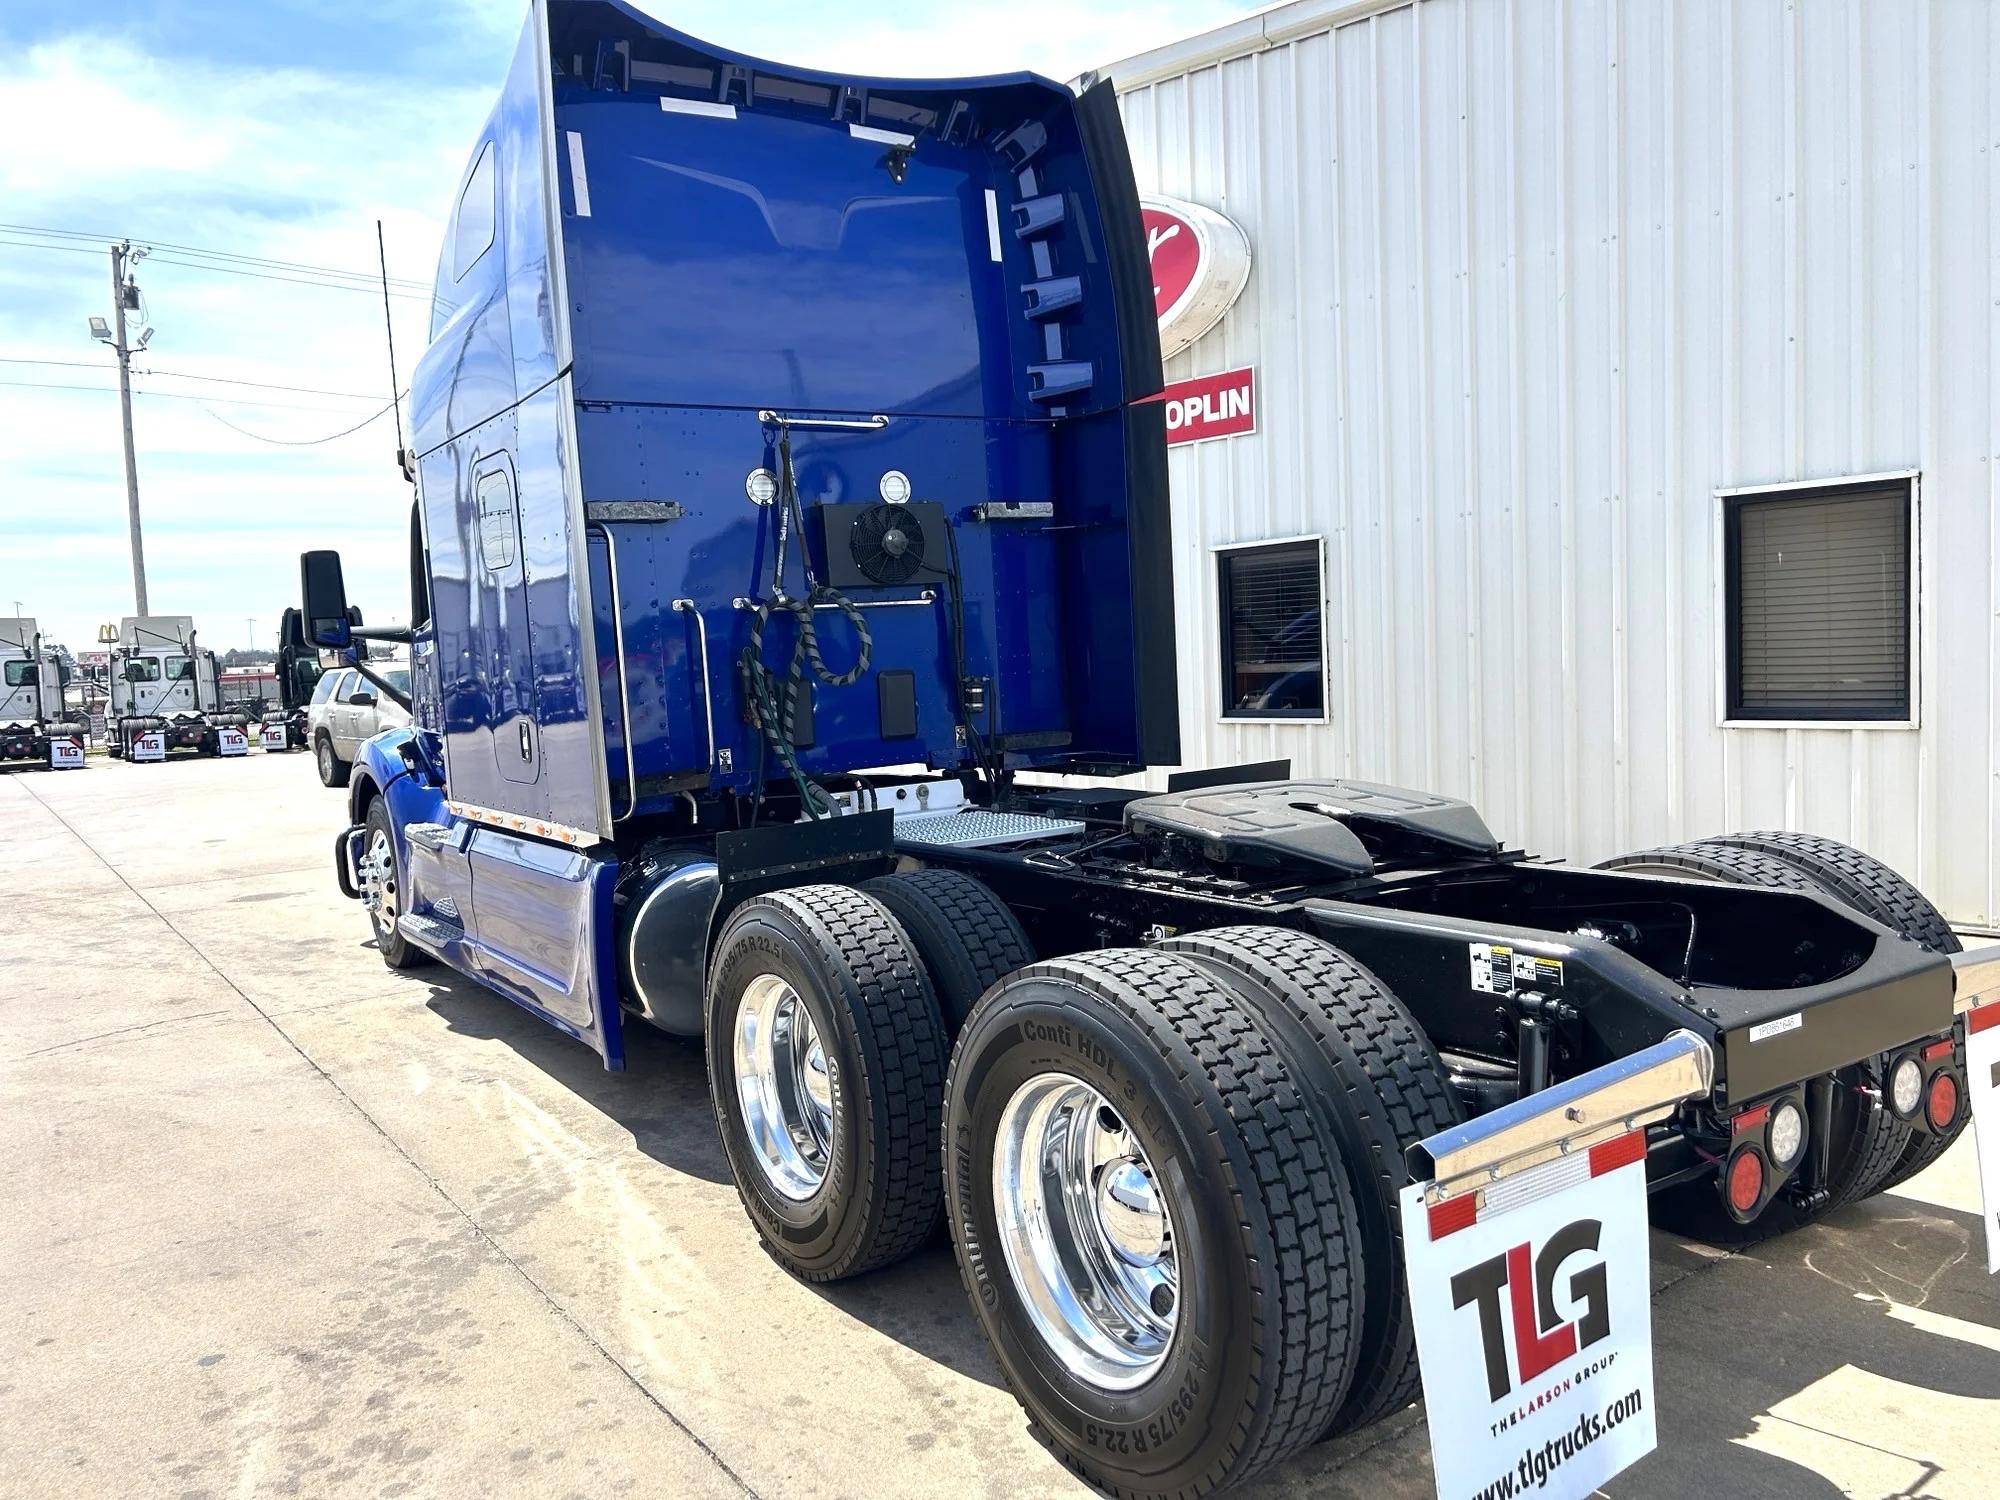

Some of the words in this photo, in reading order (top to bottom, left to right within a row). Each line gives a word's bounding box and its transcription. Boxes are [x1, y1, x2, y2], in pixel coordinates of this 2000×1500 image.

[1166, 386, 1250, 430] OPLIN
[141, 739, 160, 750] TLG
[224, 734, 244, 745] TLG
[265, 731, 282, 742] TLG
[57, 747, 78, 757] TLG
[1023, 1020, 1071, 1047] Conti
[1450, 1218, 1611, 1404] TLG
[1574, 1353, 1615, 1385] GROUP
[1471, 1388, 1643, 1500] ww.tlgtrucks.com
